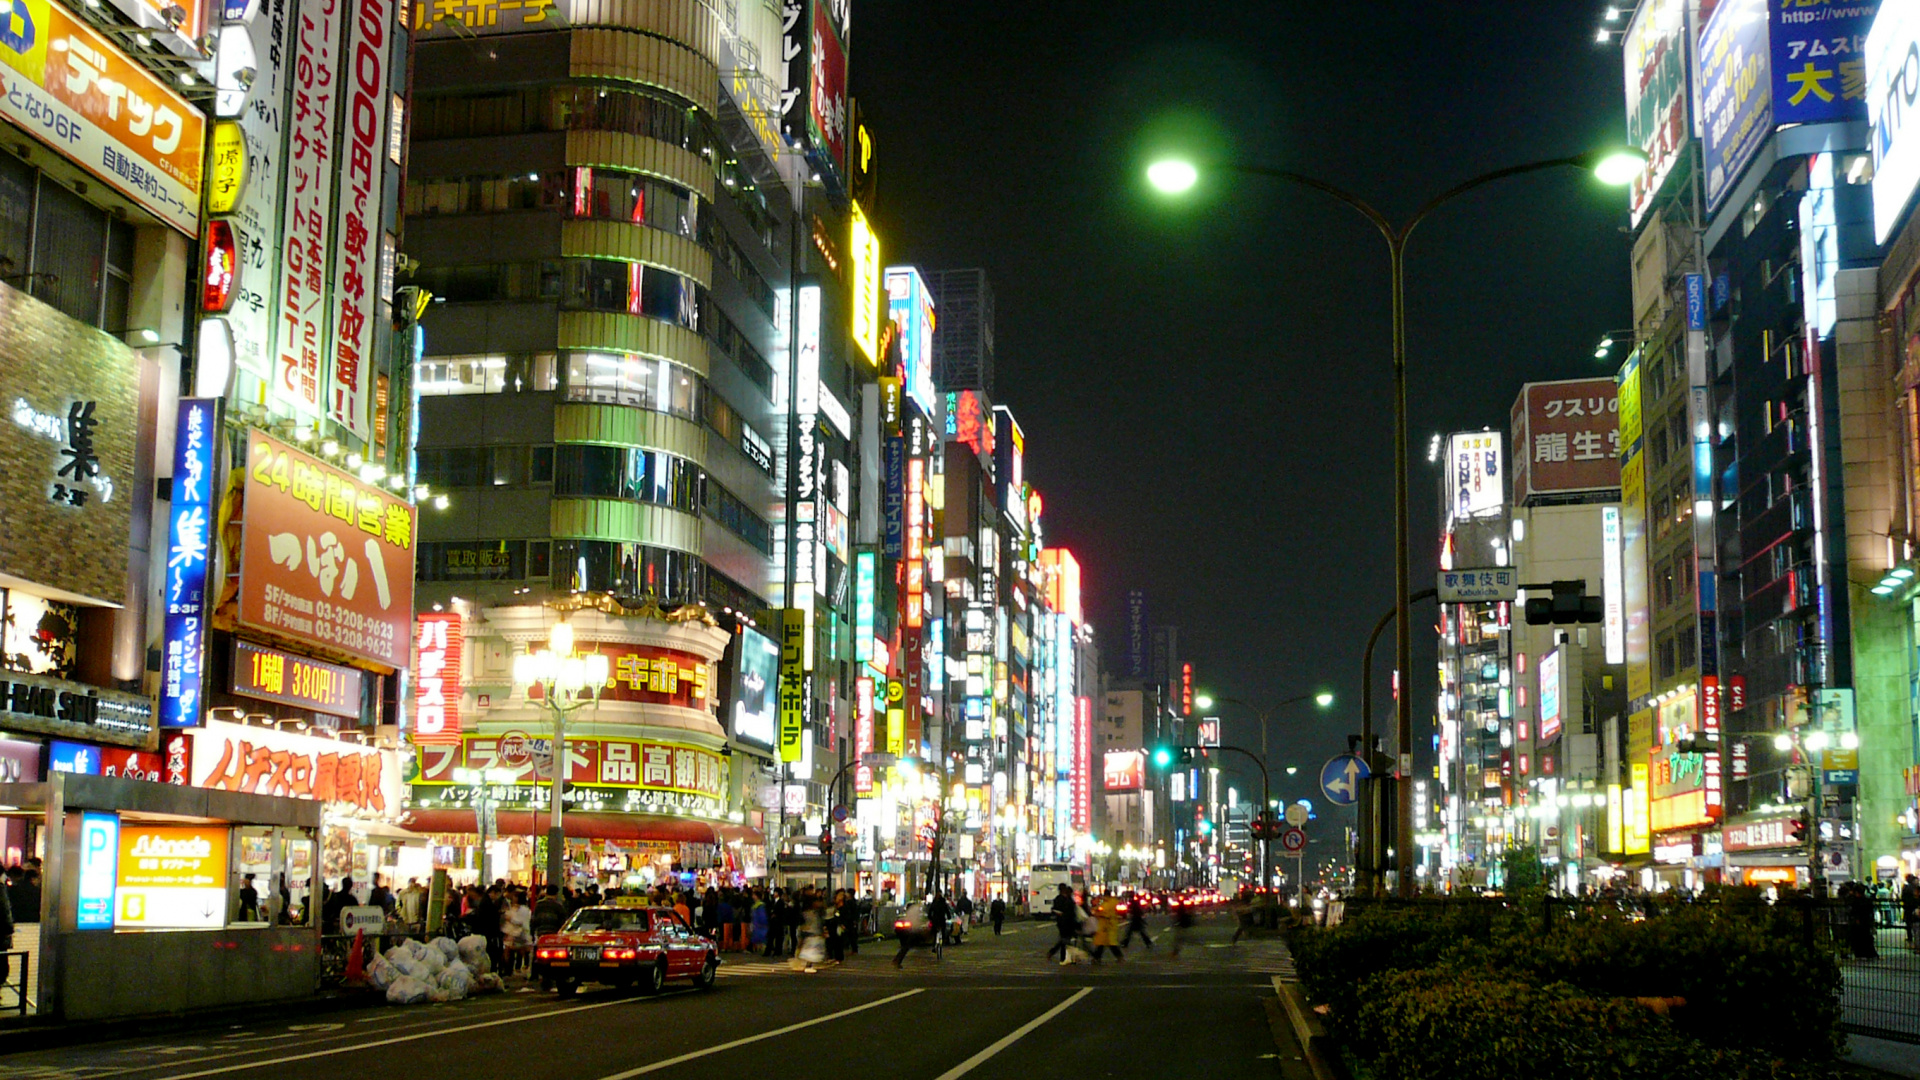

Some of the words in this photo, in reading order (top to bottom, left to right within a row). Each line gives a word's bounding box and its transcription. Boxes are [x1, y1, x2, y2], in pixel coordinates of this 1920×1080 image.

[66, 34, 183, 155] ディック
[103, 146, 197, 219] 自動契約コーナー
[253, 441, 412, 551] 24時間営業
[886, 492, 901, 536] エイワ
[168, 506, 207, 568] 集
[269, 531, 392, 611] つぼ八
[1445, 572, 1510, 588] 歌舞伎町
[1457, 588, 1499, 598] Kabukicho
[315, 621, 393, 660] 03-3208-9625
[316, 600, 394, 640] 03-3208-9623
[183, 617, 198, 674] ワインと
[252, 653, 284, 695] 1時間
[417, 620, 449, 734] パチスロ
[88, 828, 107, 866] P
